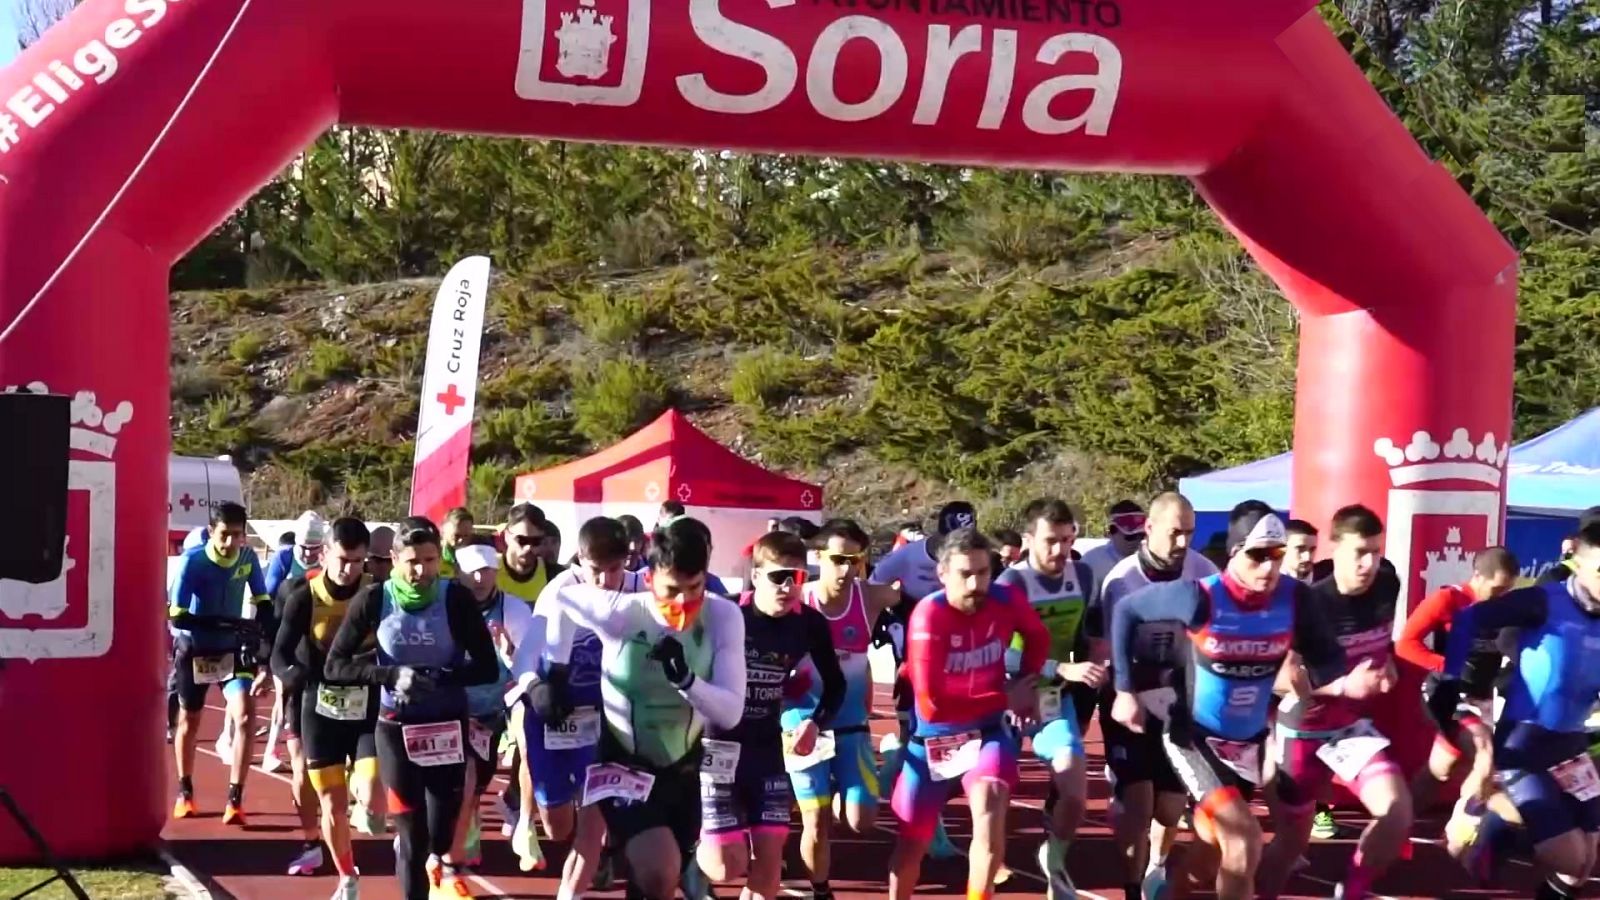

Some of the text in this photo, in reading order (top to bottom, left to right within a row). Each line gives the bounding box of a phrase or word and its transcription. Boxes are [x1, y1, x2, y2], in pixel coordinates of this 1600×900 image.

[675, 0, 1123, 137] Soria
[447, 279, 472, 374] Cruz Roja
